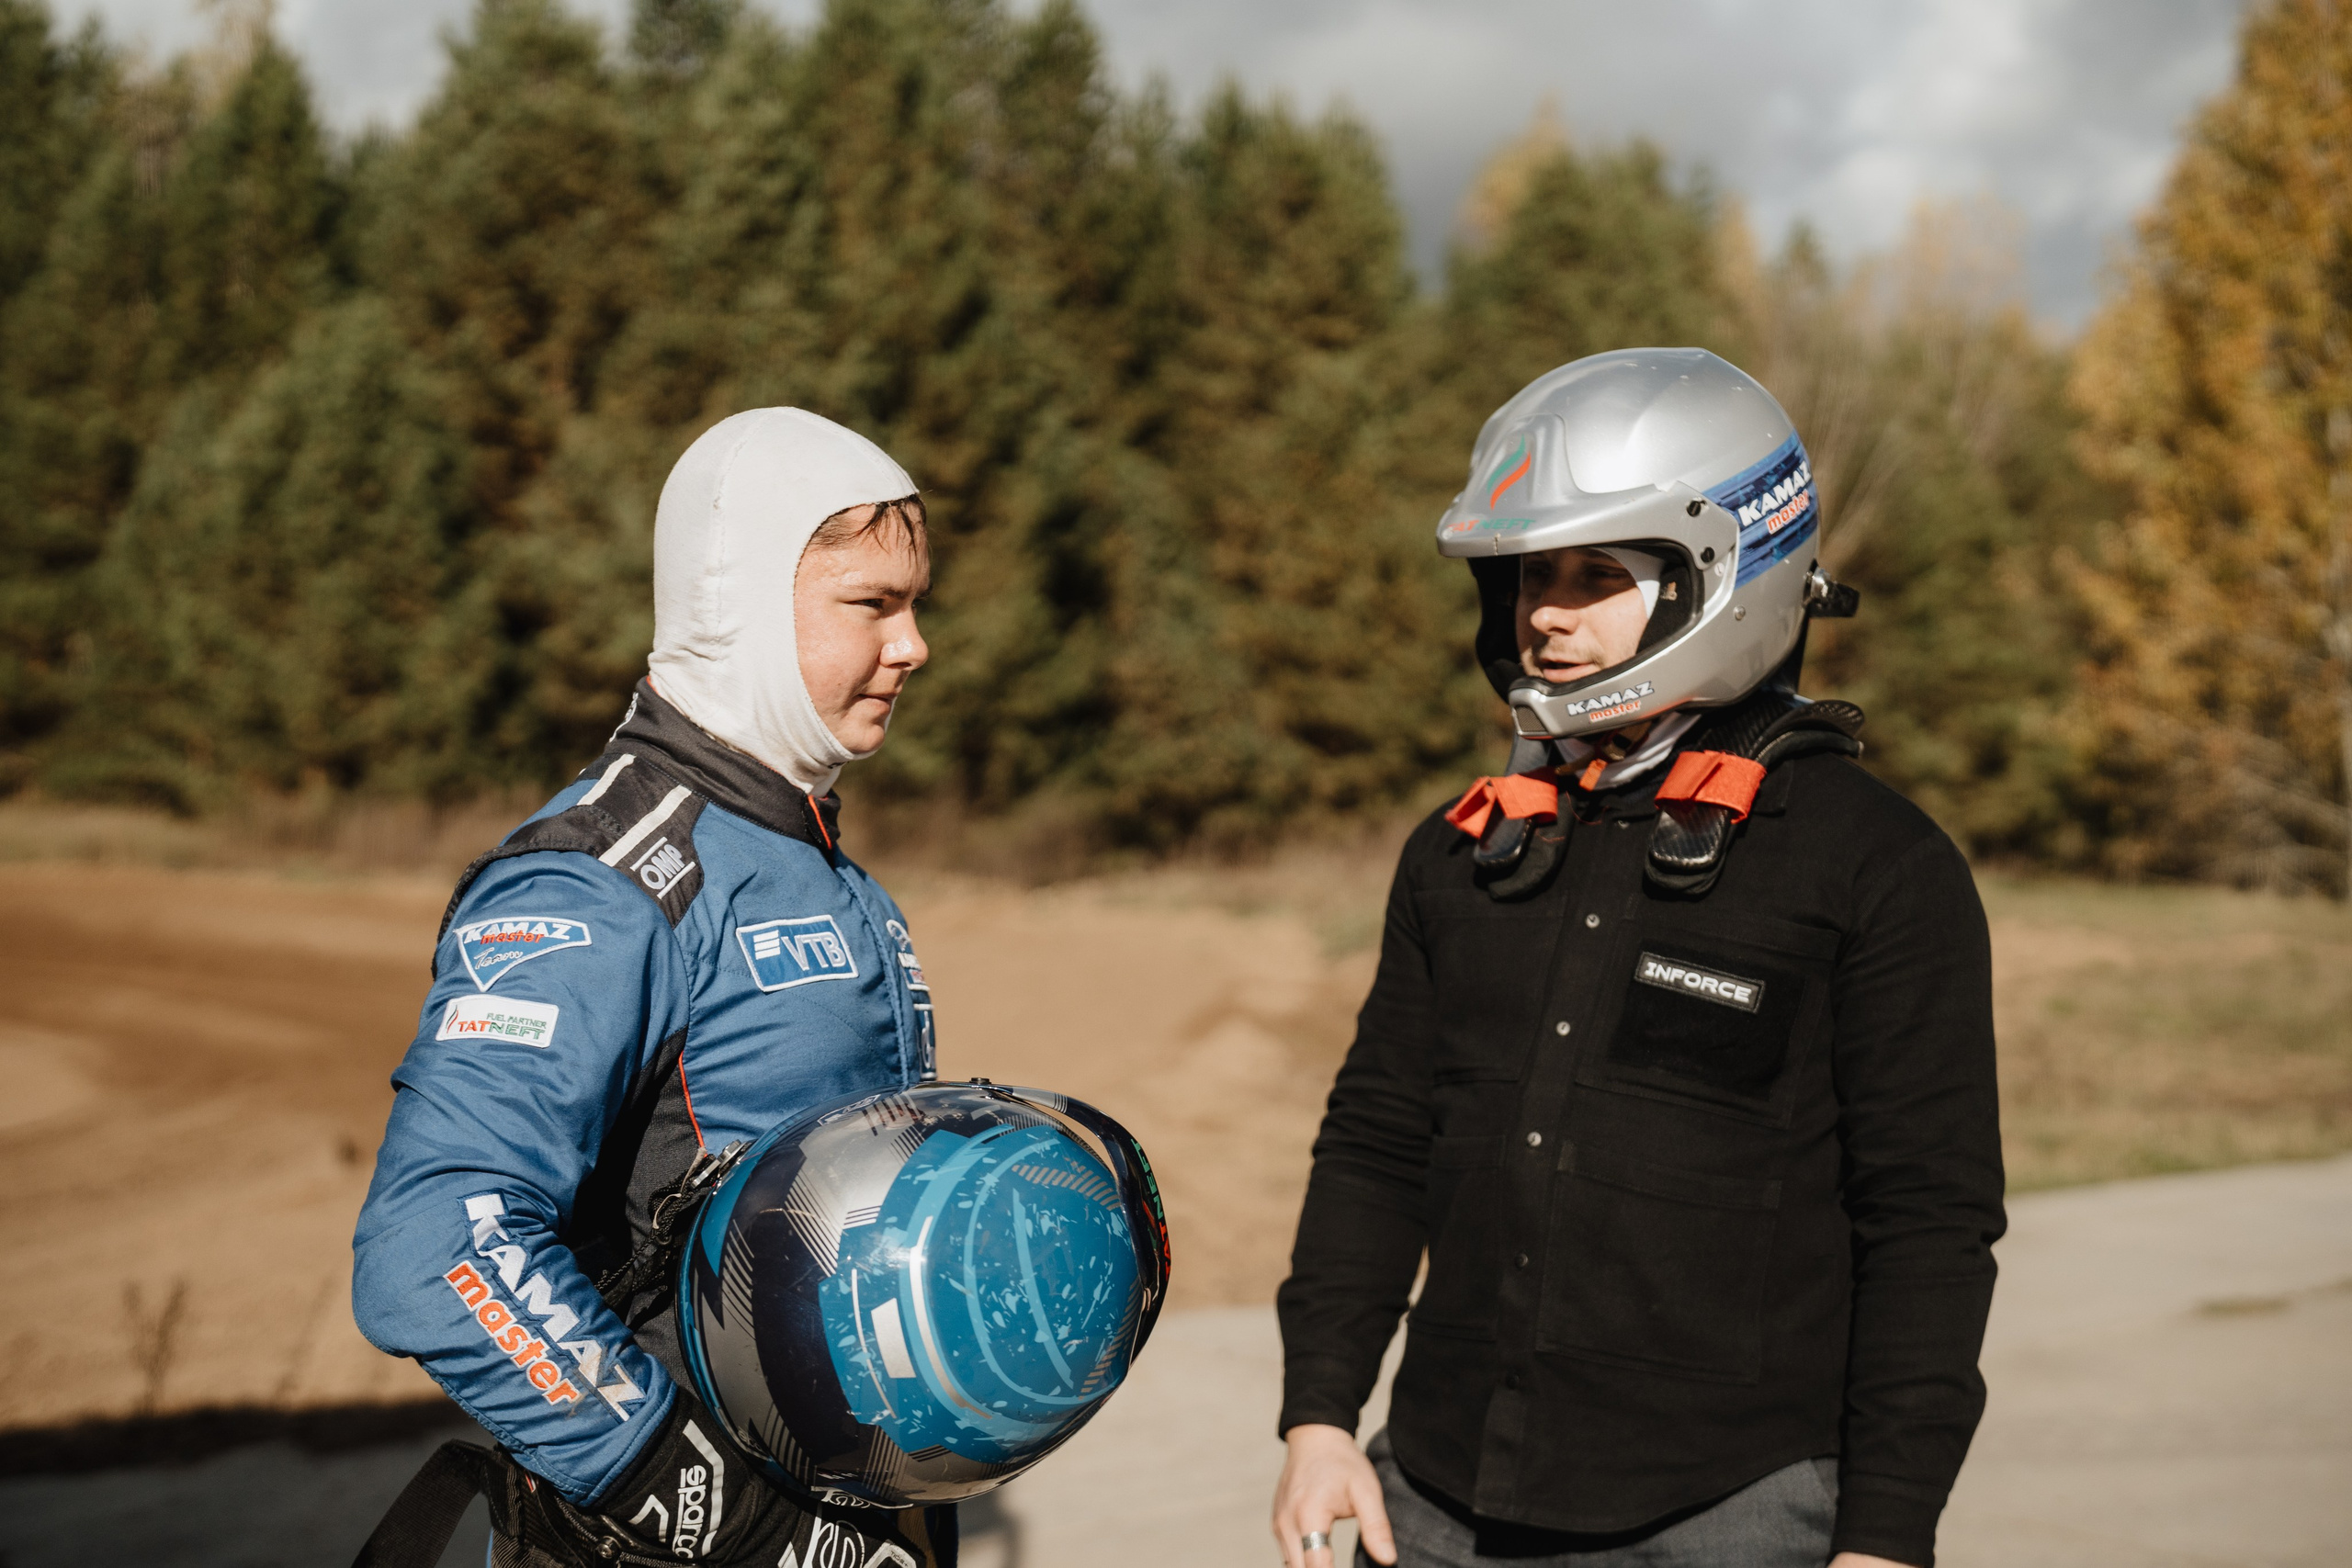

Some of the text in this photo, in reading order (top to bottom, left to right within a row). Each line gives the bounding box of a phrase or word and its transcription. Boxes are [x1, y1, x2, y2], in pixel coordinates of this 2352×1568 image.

[1737, 460, 1812, 527] KAMAZ
[1766, 489, 1810, 535] master
[1566, 681, 1655, 716] KAMAZ
[1589, 700, 1642, 723] master
[640, 843, 684, 890] OMP
[463, 921, 572, 944] KAMAZ
[480, 930, 545, 945] master
[780, 931, 847, 971] VTB
[473, 947, 524, 970] Team
[1643, 961, 1752, 1004] INFORCE
[458, 1020, 547, 1040] TATNEFT
[486, 1012, 548, 1029] FUEL PARTNER
[464, 1193, 645, 1422] KAMAZ
[443, 1260, 582, 1405] master
[673, 1464, 707, 1560] sparco
